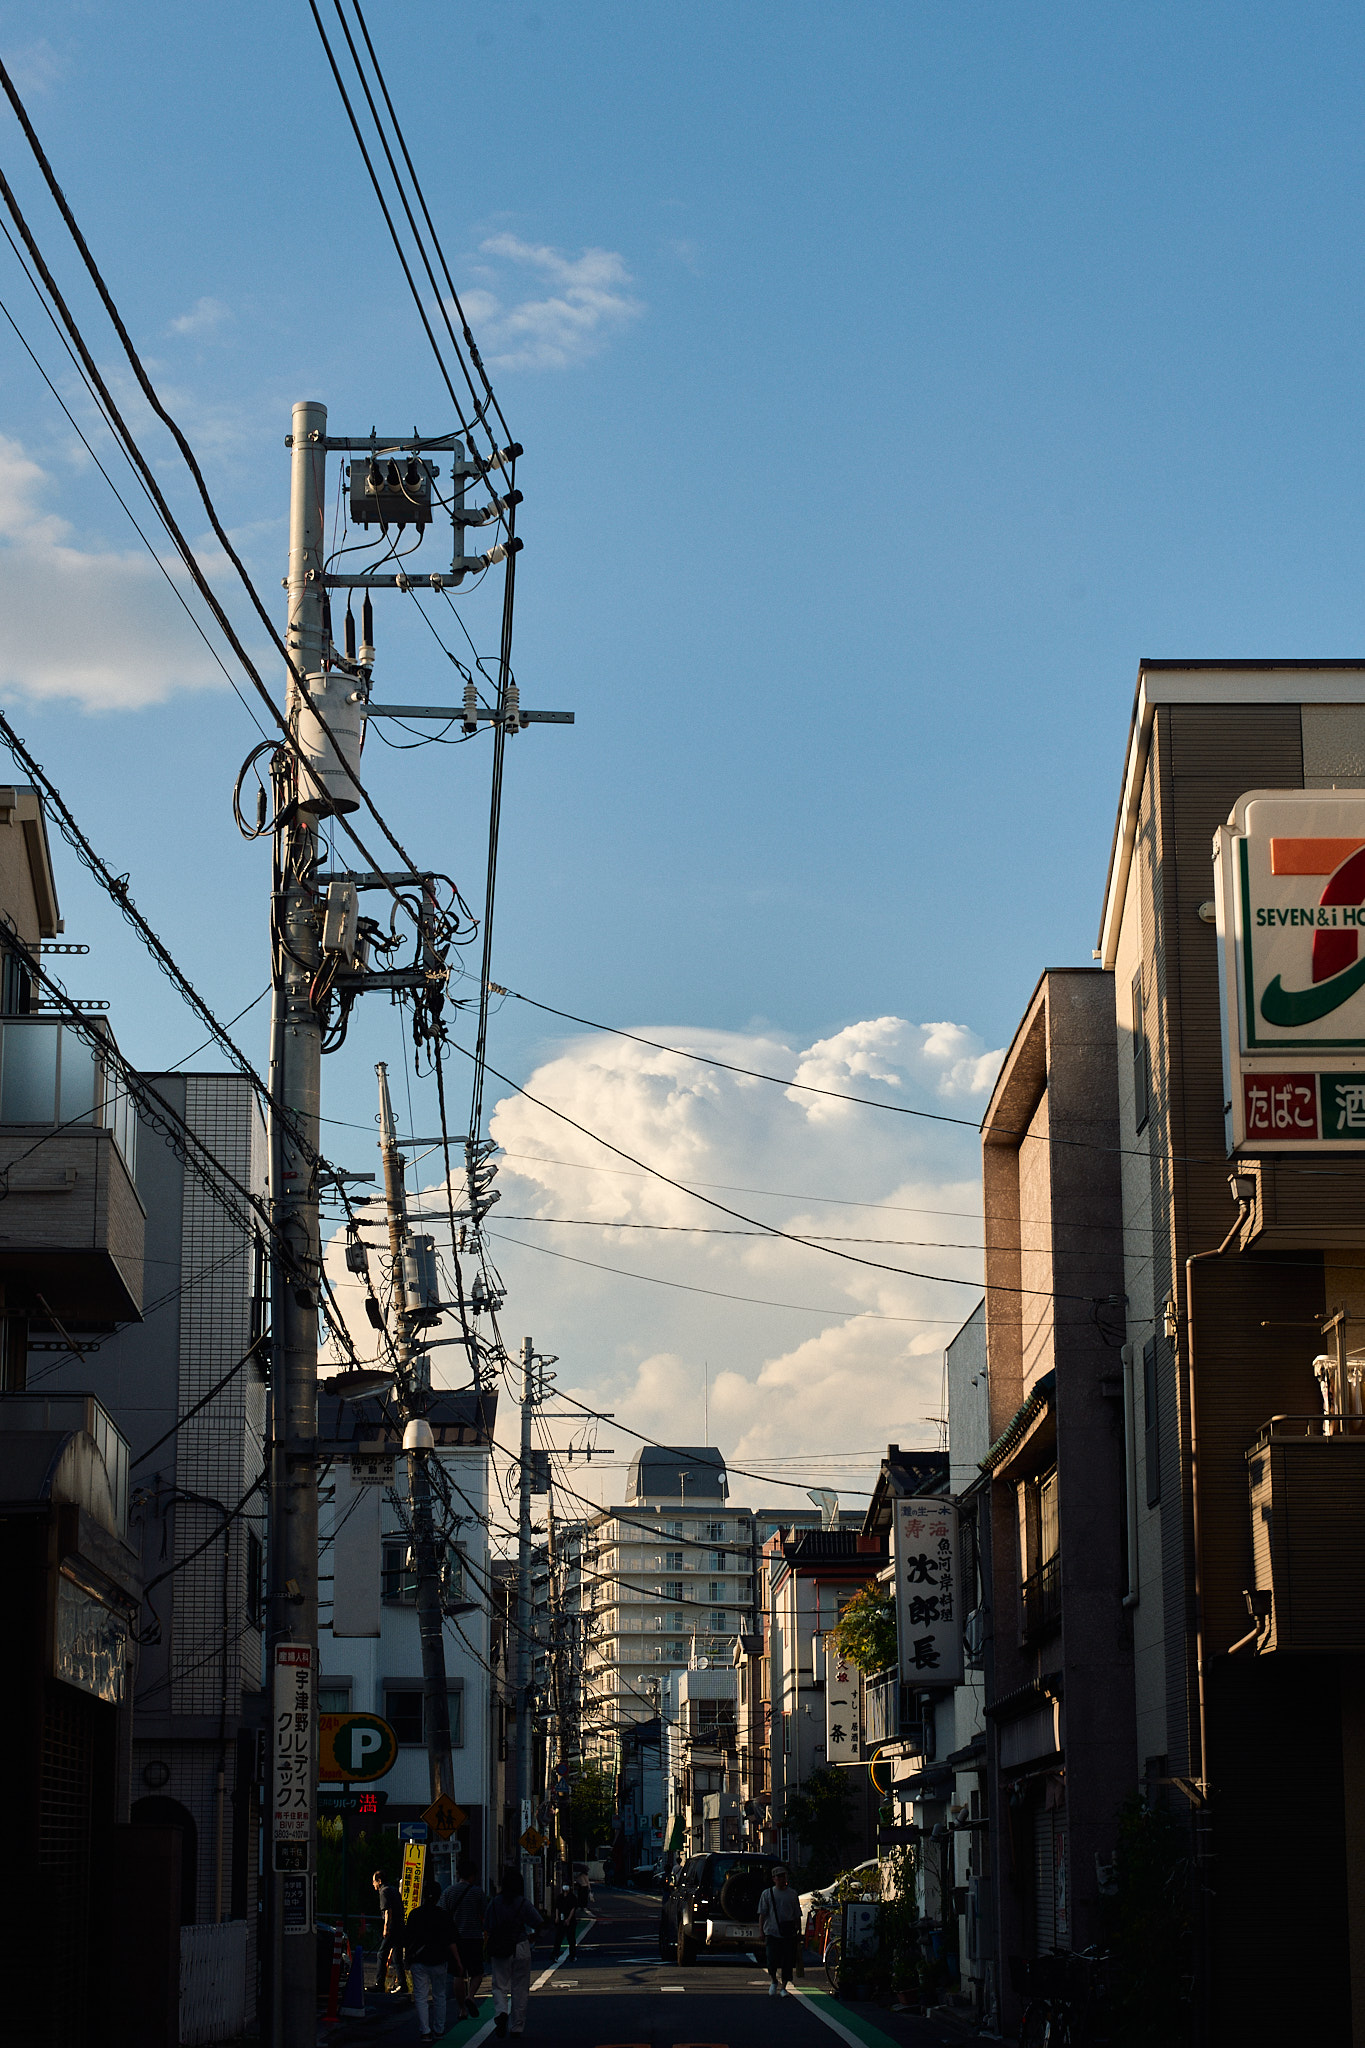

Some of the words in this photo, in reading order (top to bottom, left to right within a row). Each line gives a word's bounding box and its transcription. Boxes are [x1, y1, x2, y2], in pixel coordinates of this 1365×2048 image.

[1248, 1083, 1314, 1128] たばこ
[352, 1456, 393, 1465] 防犯カメラ
[936, 1538, 955, 1623] 魚河岸料理
[906, 1553, 942, 1670] 次郎長
[295, 1669, 309, 1808] 宇津野レディス
[830, 1699, 849, 1744] 一条
[276, 1712, 293, 1808] クリニック
[351, 1727, 383, 1769] P
[360, 1793, 378, 1813] 満
